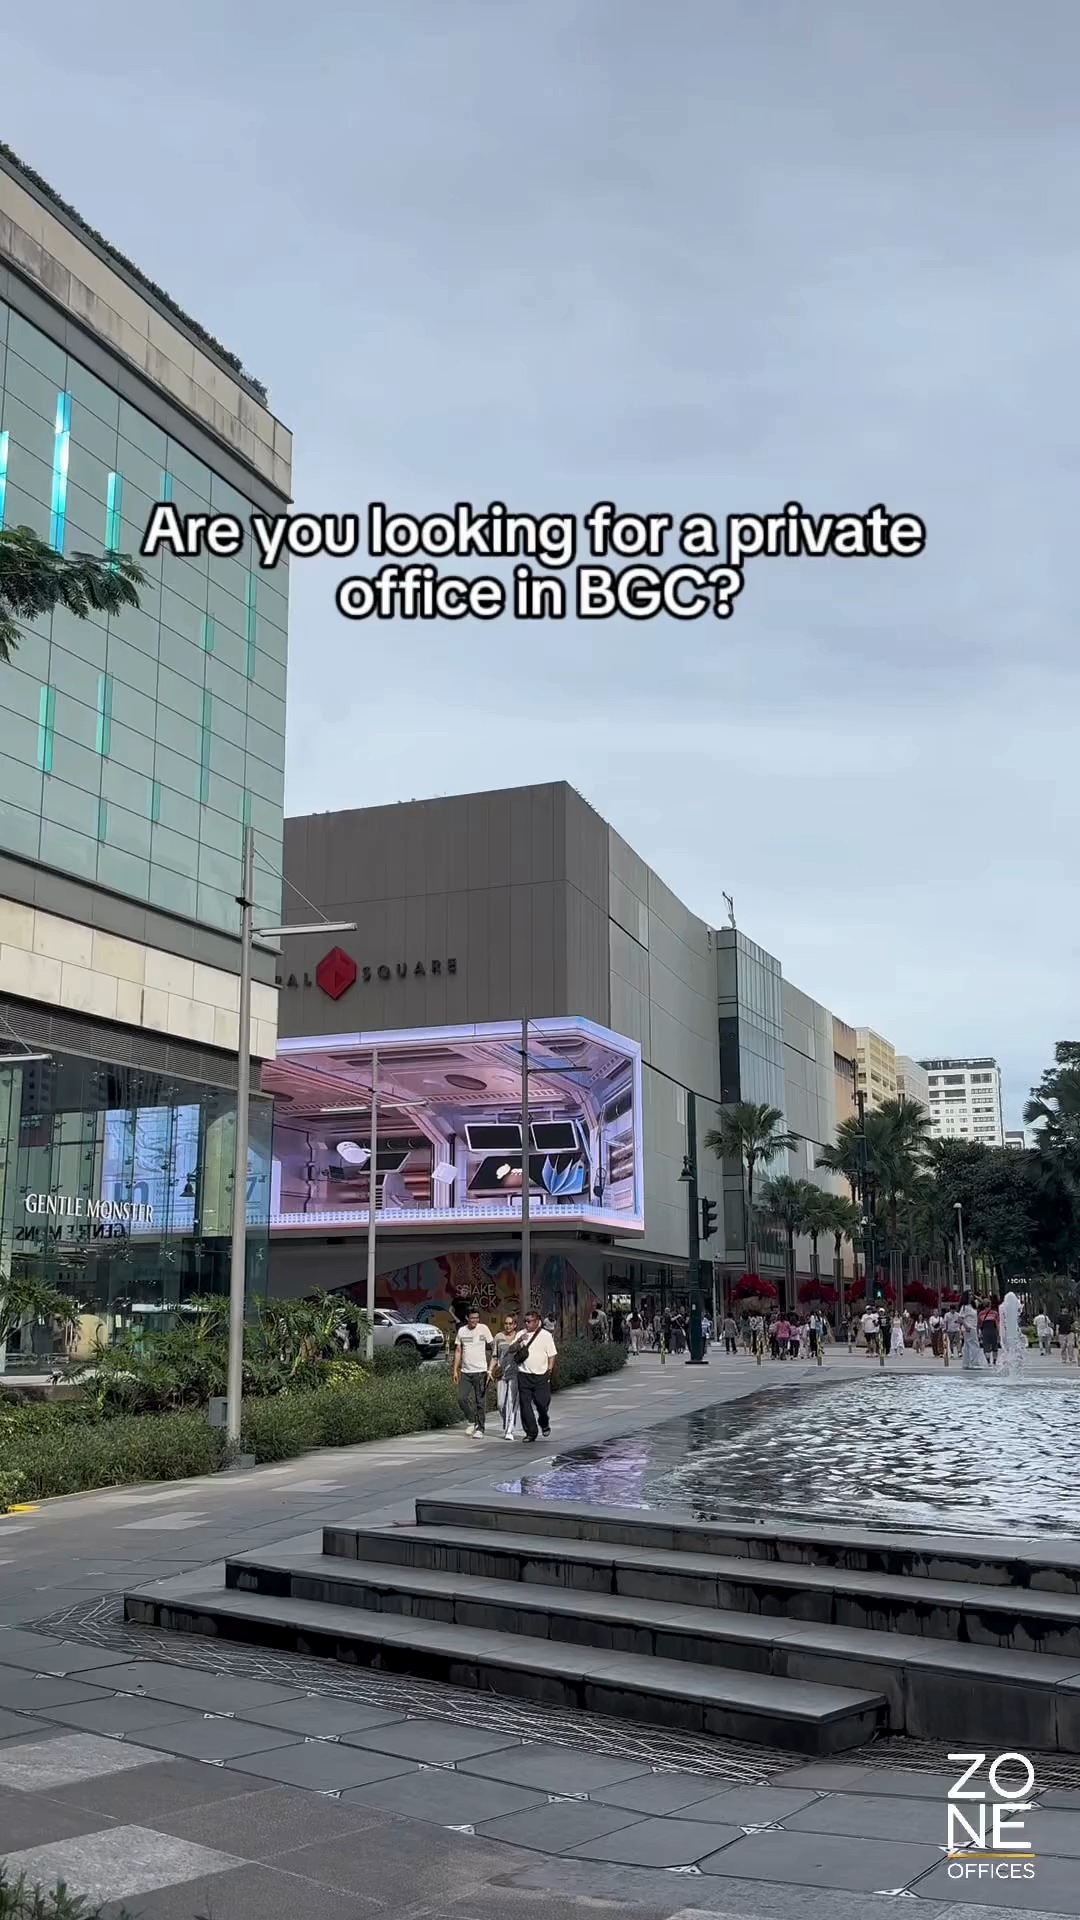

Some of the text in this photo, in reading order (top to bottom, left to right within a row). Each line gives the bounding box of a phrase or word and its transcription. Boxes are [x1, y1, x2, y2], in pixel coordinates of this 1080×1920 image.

[362, 958, 457, 982] SQUARE
[25, 1193, 154, 1223] GENTLE MONSTER
